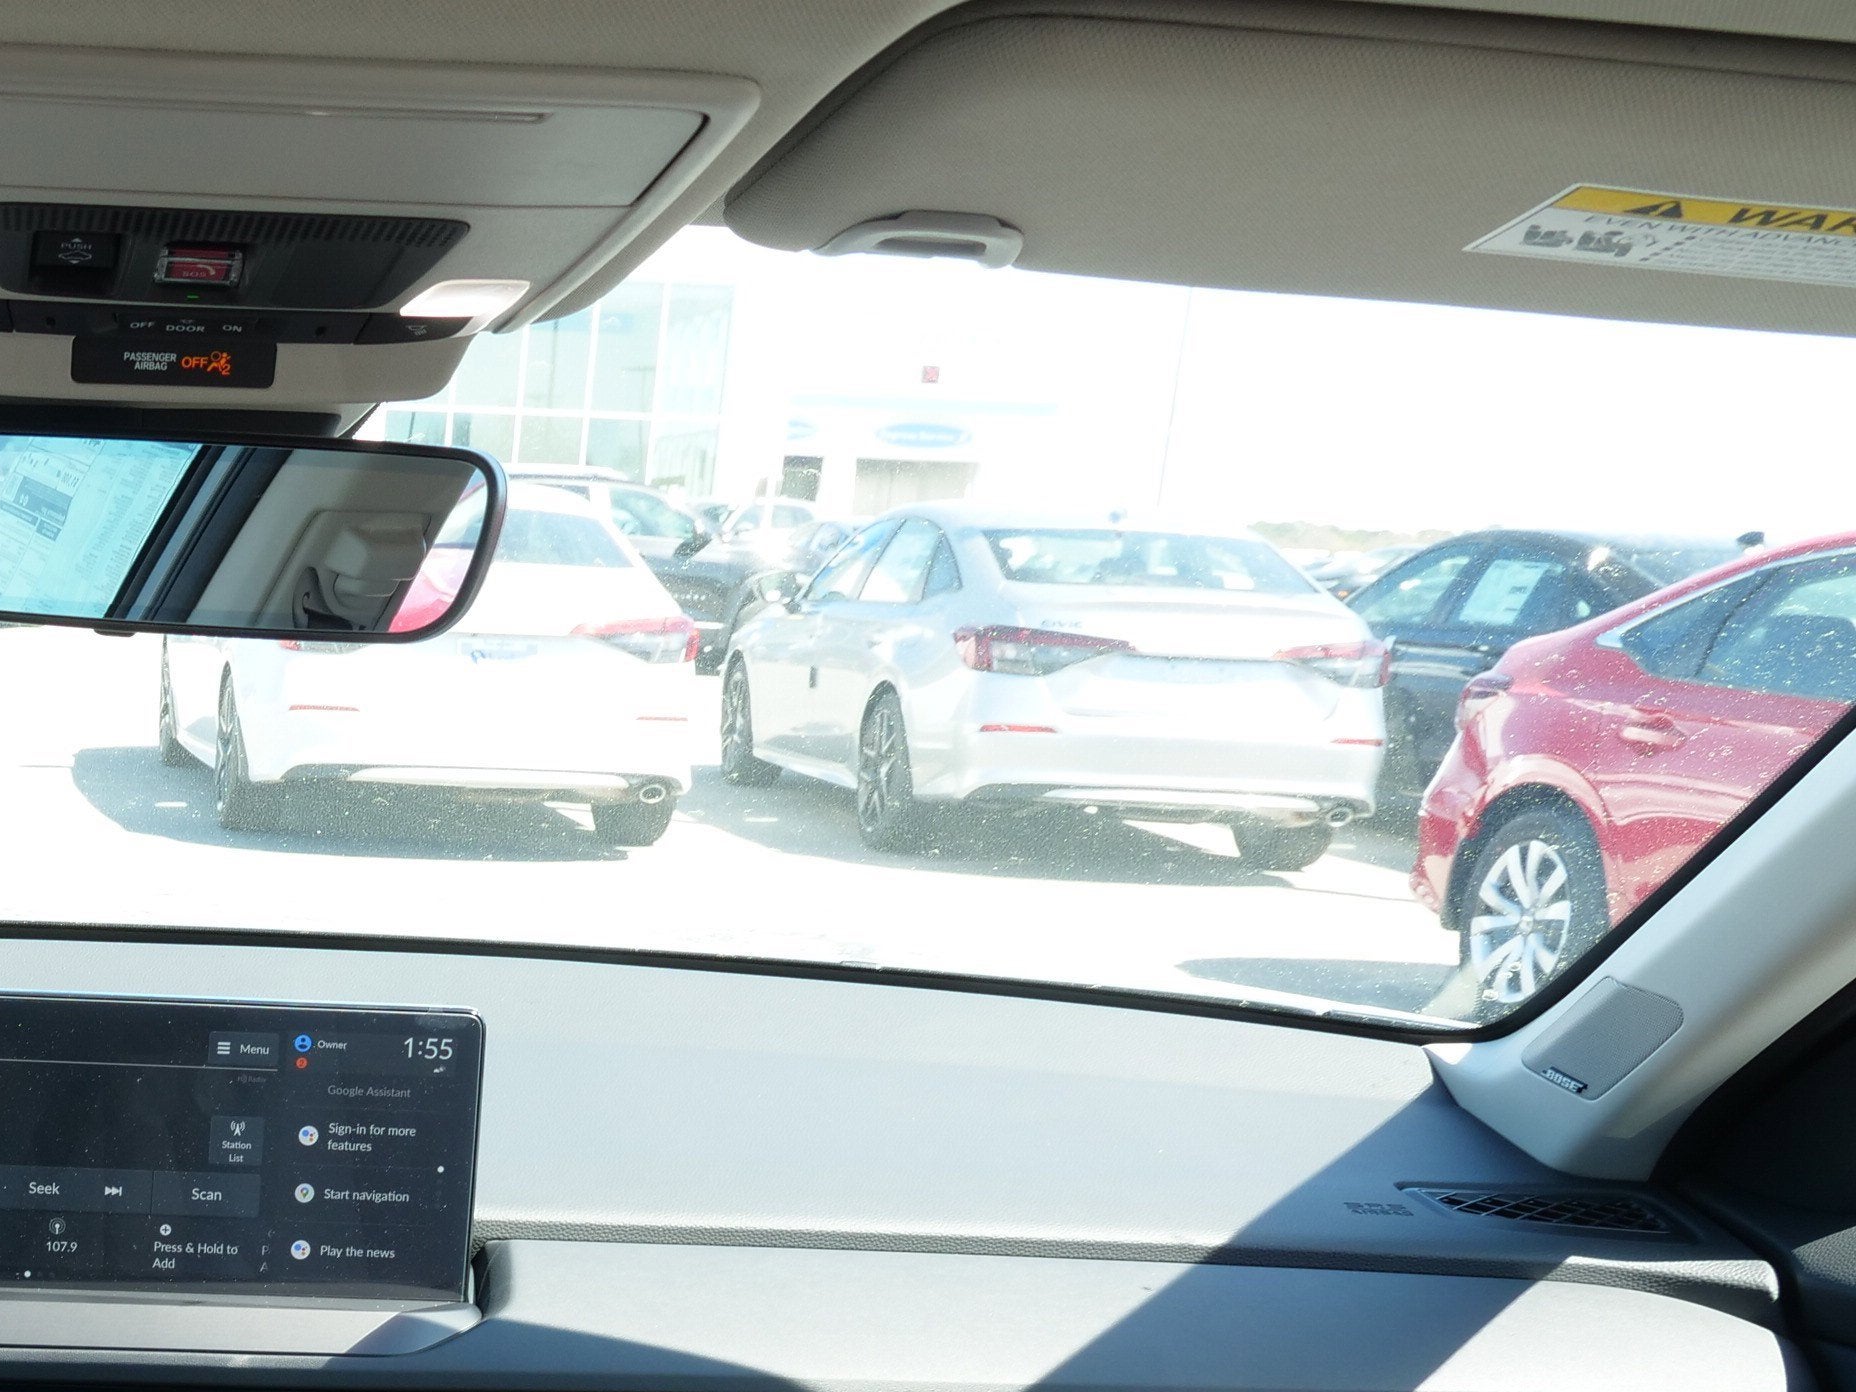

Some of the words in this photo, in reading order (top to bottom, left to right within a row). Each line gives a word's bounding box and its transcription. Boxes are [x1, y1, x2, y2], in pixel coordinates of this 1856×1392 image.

[60, 243, 93, 251] PUSH
[129, 321, 156, 329] OFF
[165, 324, 206, 333] DOOR
[222, 324, 243, 333] ON
[123, 351, 178, 364] PASSENGER
[180, 356, 209, 370] OFF
[134, 361, 168, 372] AIRBAG
[239, 1044, 270, 1055] Menu
[317, 1040, 348, 1050] Owner
[404, 1037, 453, 1060] 1:55
[327, 1084, 364, 1097] Google
[366, 1086, 411, 1098] Assistant
[328, 1122, 367, 1137] Sign-in
[369, 1124, 386, 1135] for
[388, 1127, 417, 1137] more
[221, 1140, 252, 1150] Station
[327, 1139, 372, 1152] features
[228, 1153, 244, 1163] List
[29, 1181, 60, 1195] Seek
[191, 1188, 222, 1201] Scan
[323, 1188, 350, 1200] Start
[352, 1190, 410, 1203] navigation
[46, 1240, 78, 1253] 107.9
[153, 1241, 183, 1253] Press
[185, 1242, 195, 1253] &
[197, 1243, 223, 1254] Hold
[226, 1245, 239, 1255] to
[320, 1245, 343, 1258] Play
[345, 1245, 364, 1258] the
[366, 1248, 395, 1259] news
[152, 1257, 175, 1269] Add
